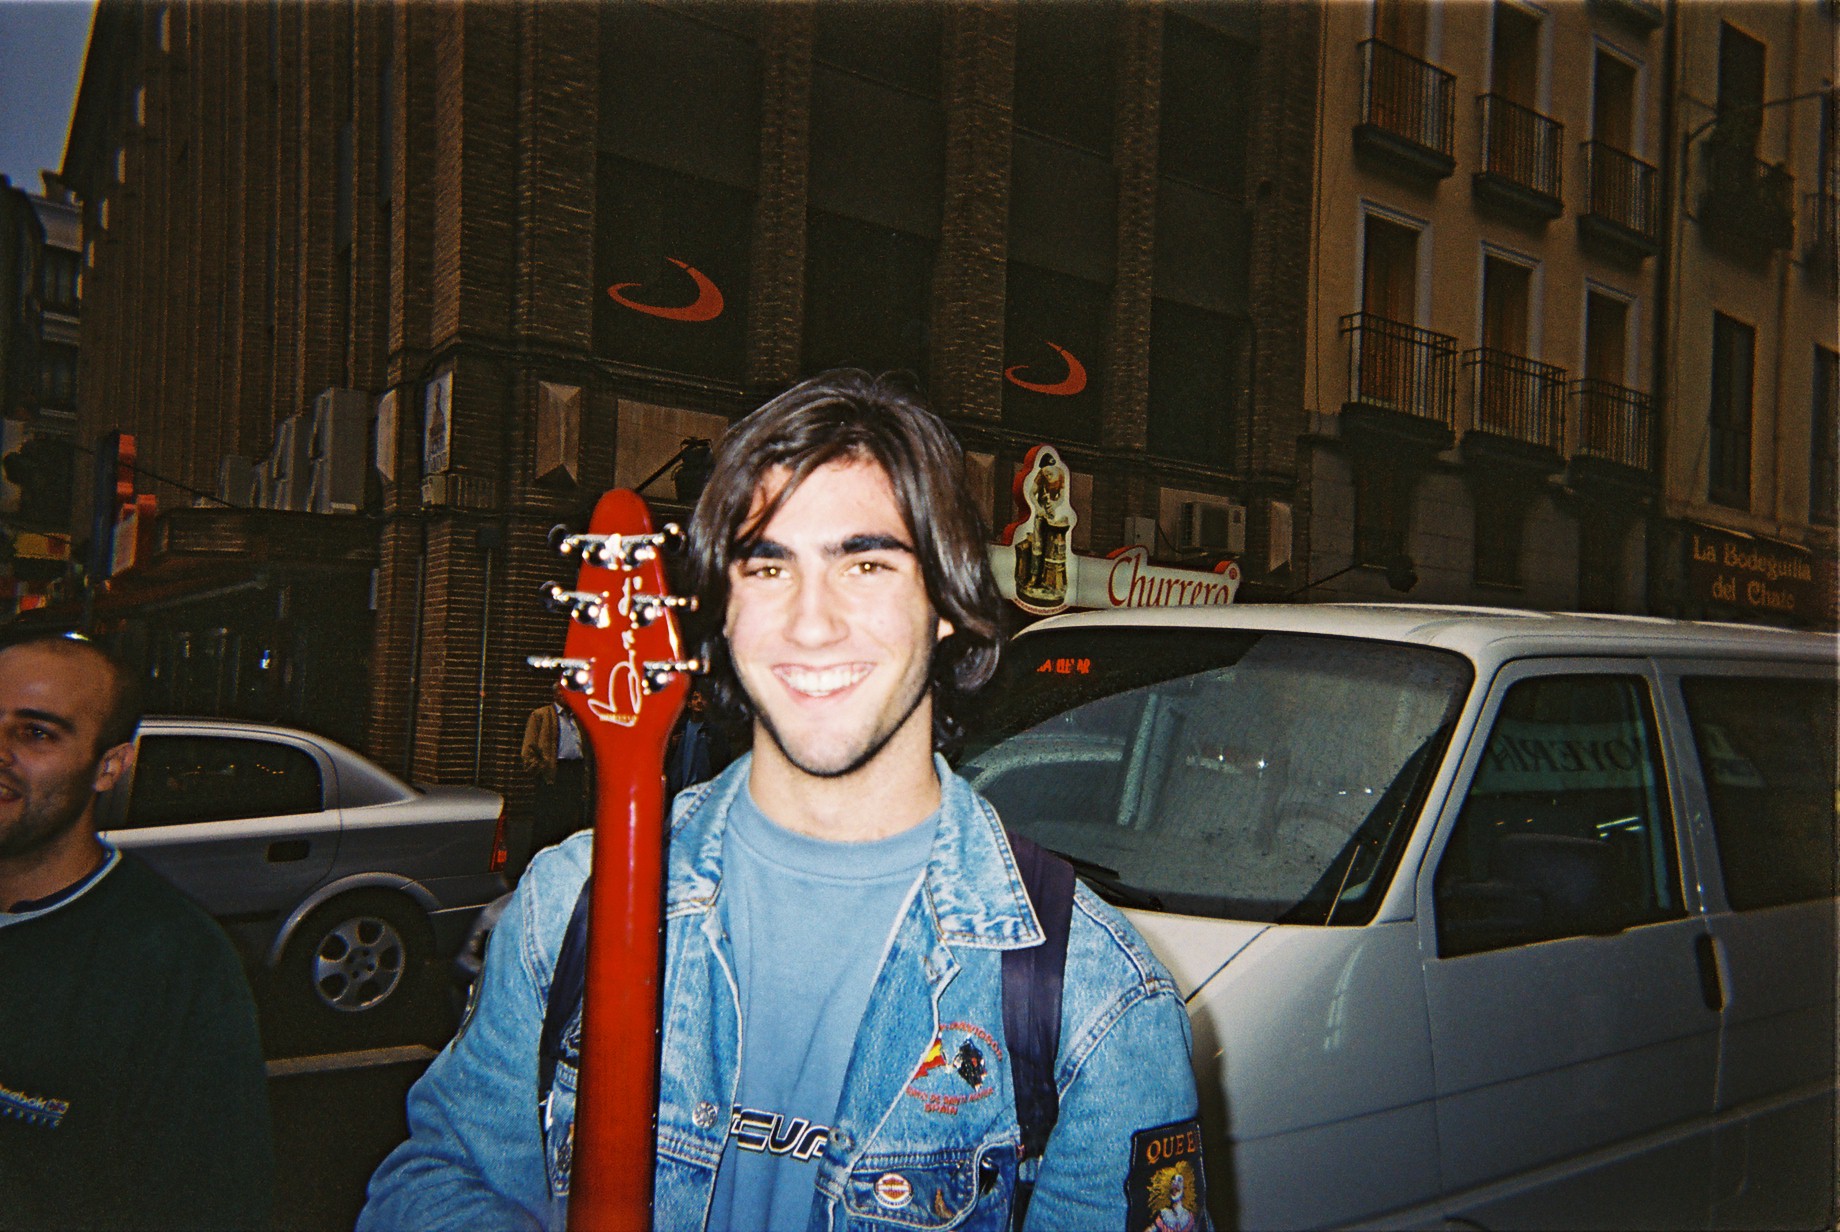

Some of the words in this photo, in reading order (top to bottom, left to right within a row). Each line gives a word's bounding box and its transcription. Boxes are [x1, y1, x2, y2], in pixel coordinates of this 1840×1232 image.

[1692, 534, 1716, 563] La
[1723, 543, 1812, 581] Bodeguilla
[1108, 553, 1229, 608] Churrero
[1712, 575, 1736, 602] del
[0, 1082, 48, 1111] eebok
[924, 1102, 959, 1116] SPAIN
[1146, 1131, 1201, 1165] QUEE
